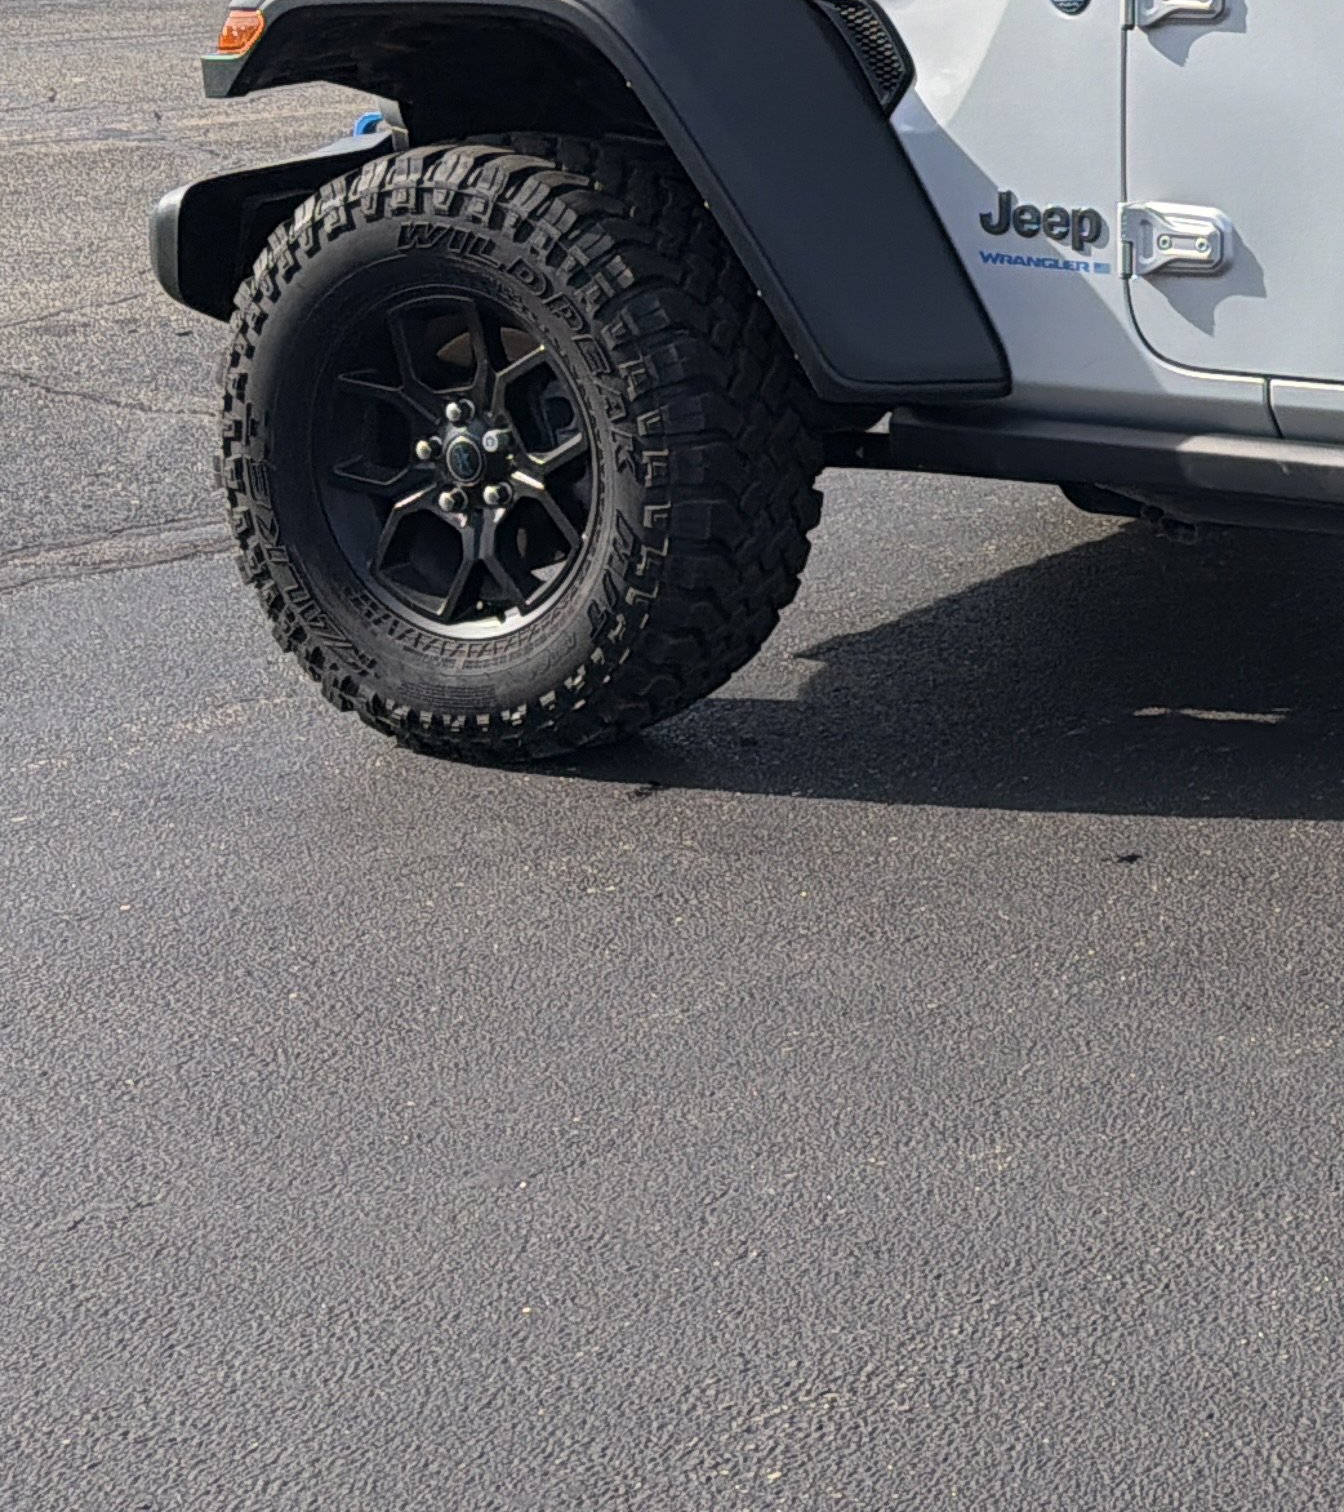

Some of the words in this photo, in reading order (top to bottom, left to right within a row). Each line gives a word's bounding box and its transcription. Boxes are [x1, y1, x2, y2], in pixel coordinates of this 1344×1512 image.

[979, 190, 1102, 251] Jeep
[979, 250, 1090, 273] WRANGLER
[397, 221, 638, 475] WILDPEAK
